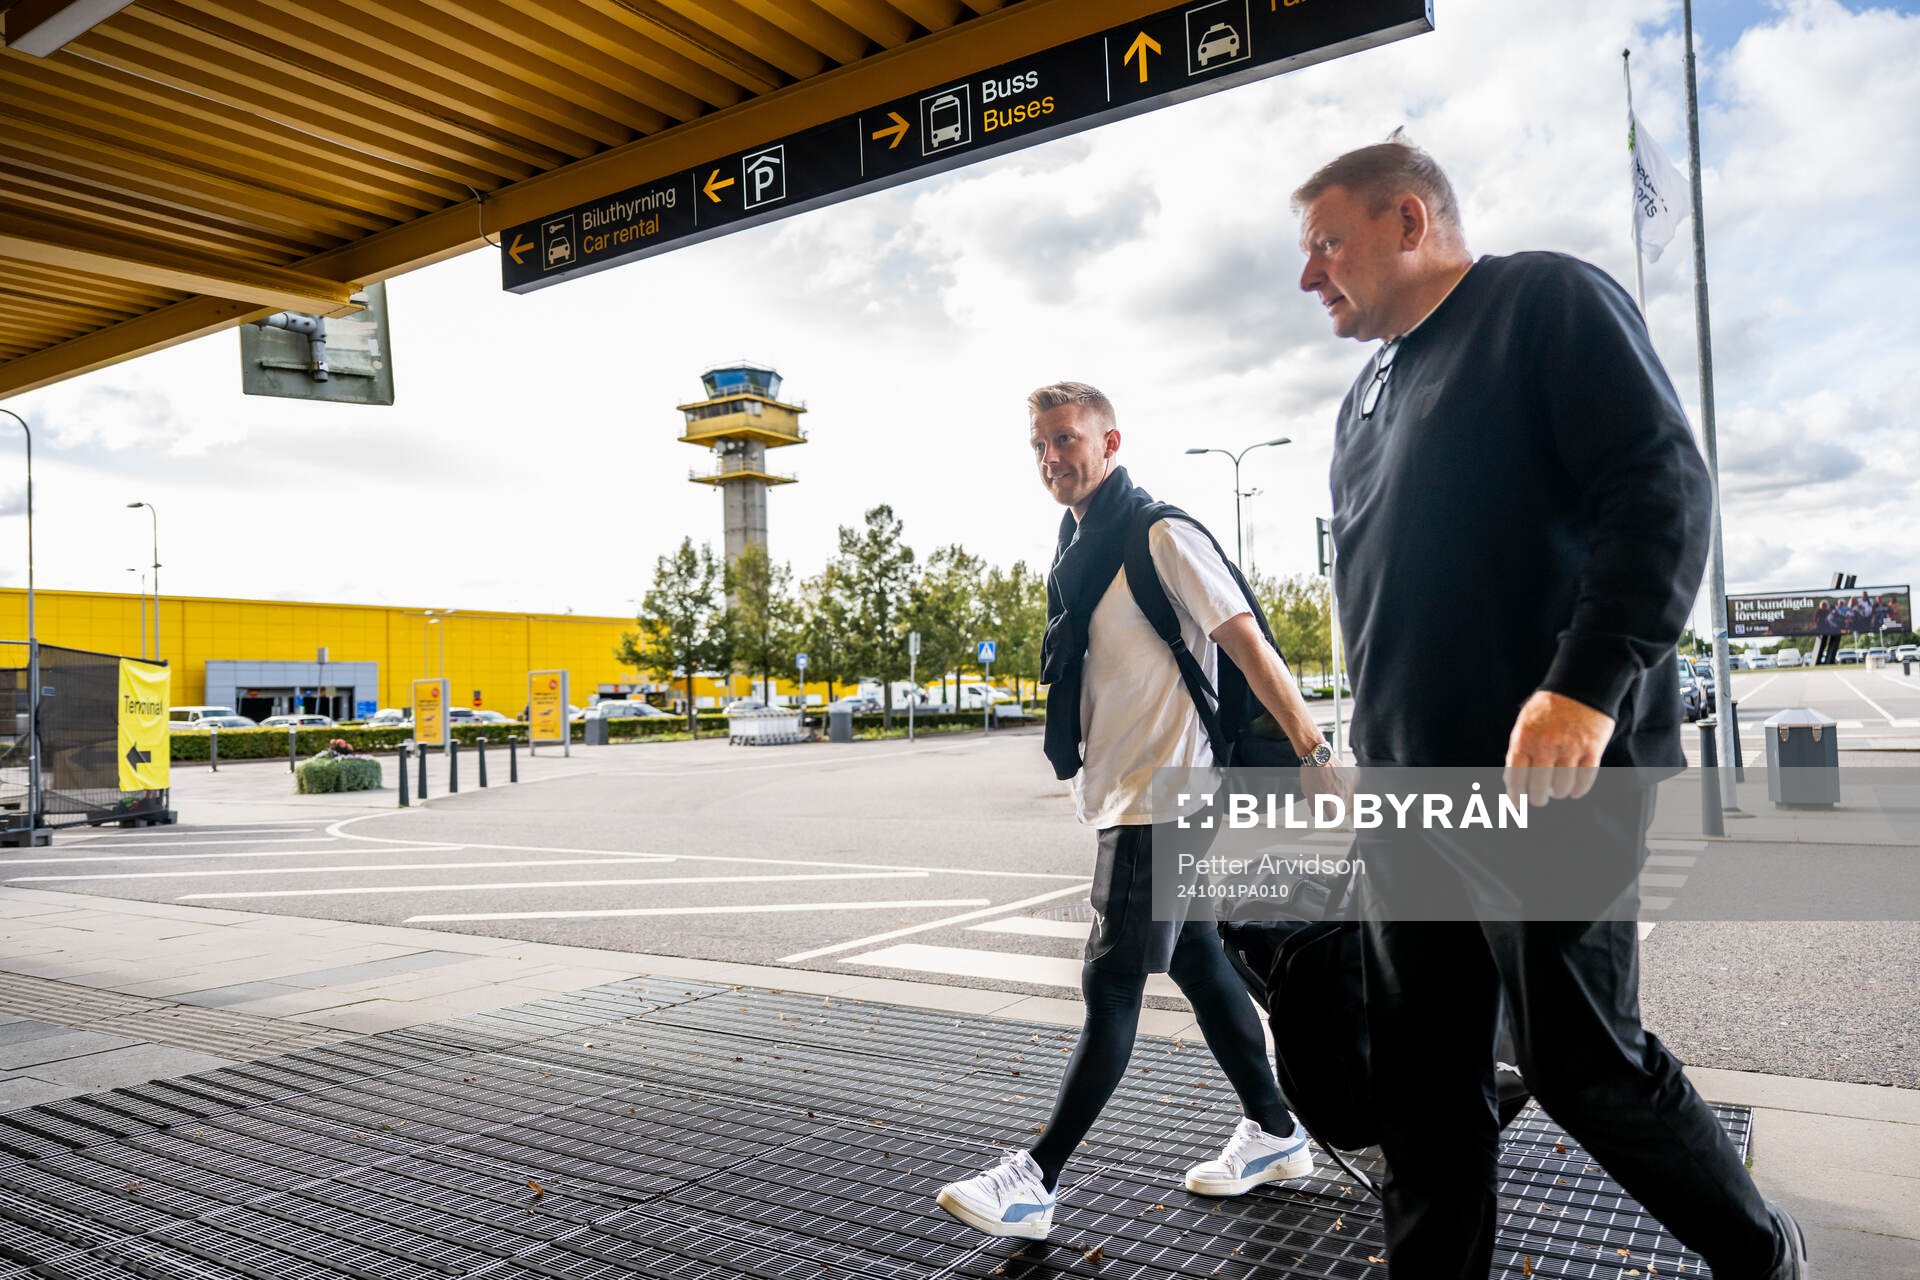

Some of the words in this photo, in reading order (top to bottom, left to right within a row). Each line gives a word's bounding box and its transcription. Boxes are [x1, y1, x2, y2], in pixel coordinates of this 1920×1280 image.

[982, 70, 1039, 104] Buss
[983, 95, 1055, 133] Buses
[754, 165, 774, 202] P
[582, 186, 676, 231] Biluthyrning
[583, 233, 609, 255] Car
[613, 213, 660, 246] rental
[1735, 600, 1755, 611] Det
[1757, 597, 1814, 611] kundägda
[1735, 609, 1785, 623] företaget
[124, 695, 163, 715] Terminal
